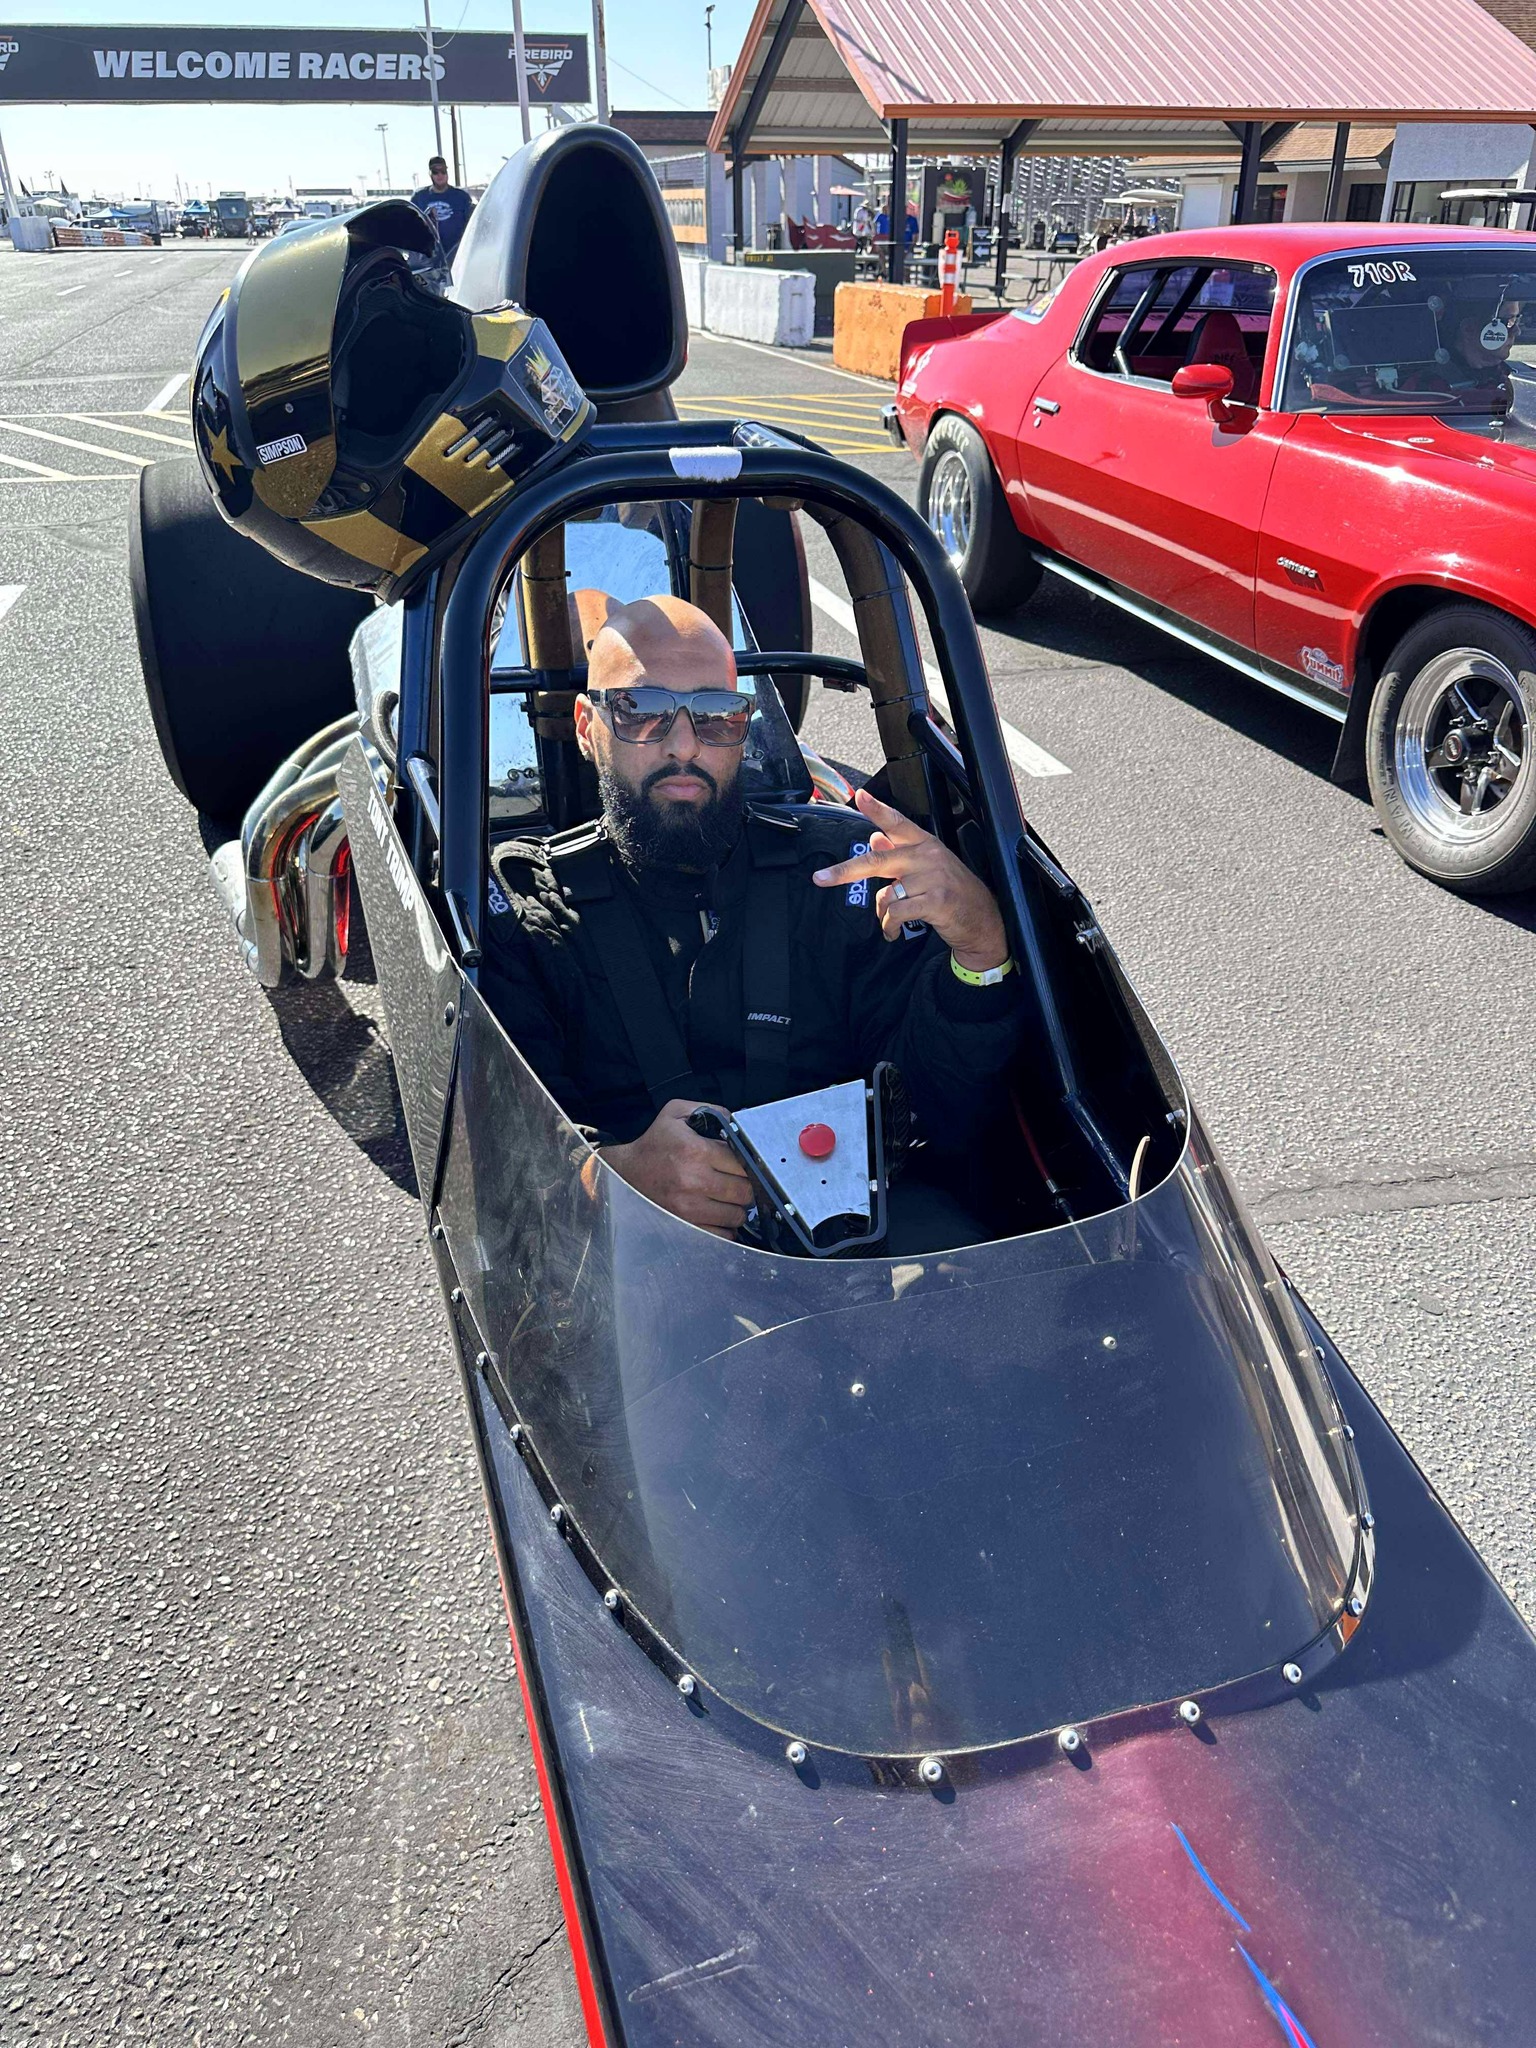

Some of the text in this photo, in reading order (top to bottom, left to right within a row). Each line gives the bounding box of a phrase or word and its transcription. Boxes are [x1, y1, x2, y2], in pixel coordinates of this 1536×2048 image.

[93, 50, 446, 81] WELCOME RACERS
[508, 49, 573, 60] FREBIRD
[1347, 261, 1417, 288] 710R
[259, 436, 302, 462] SIMPSON
[1301, 646, 1344, 683] SUMMIT
[367, 786, 389, 848] TONY
[747, 1012, 792, 1025] IMPACT
